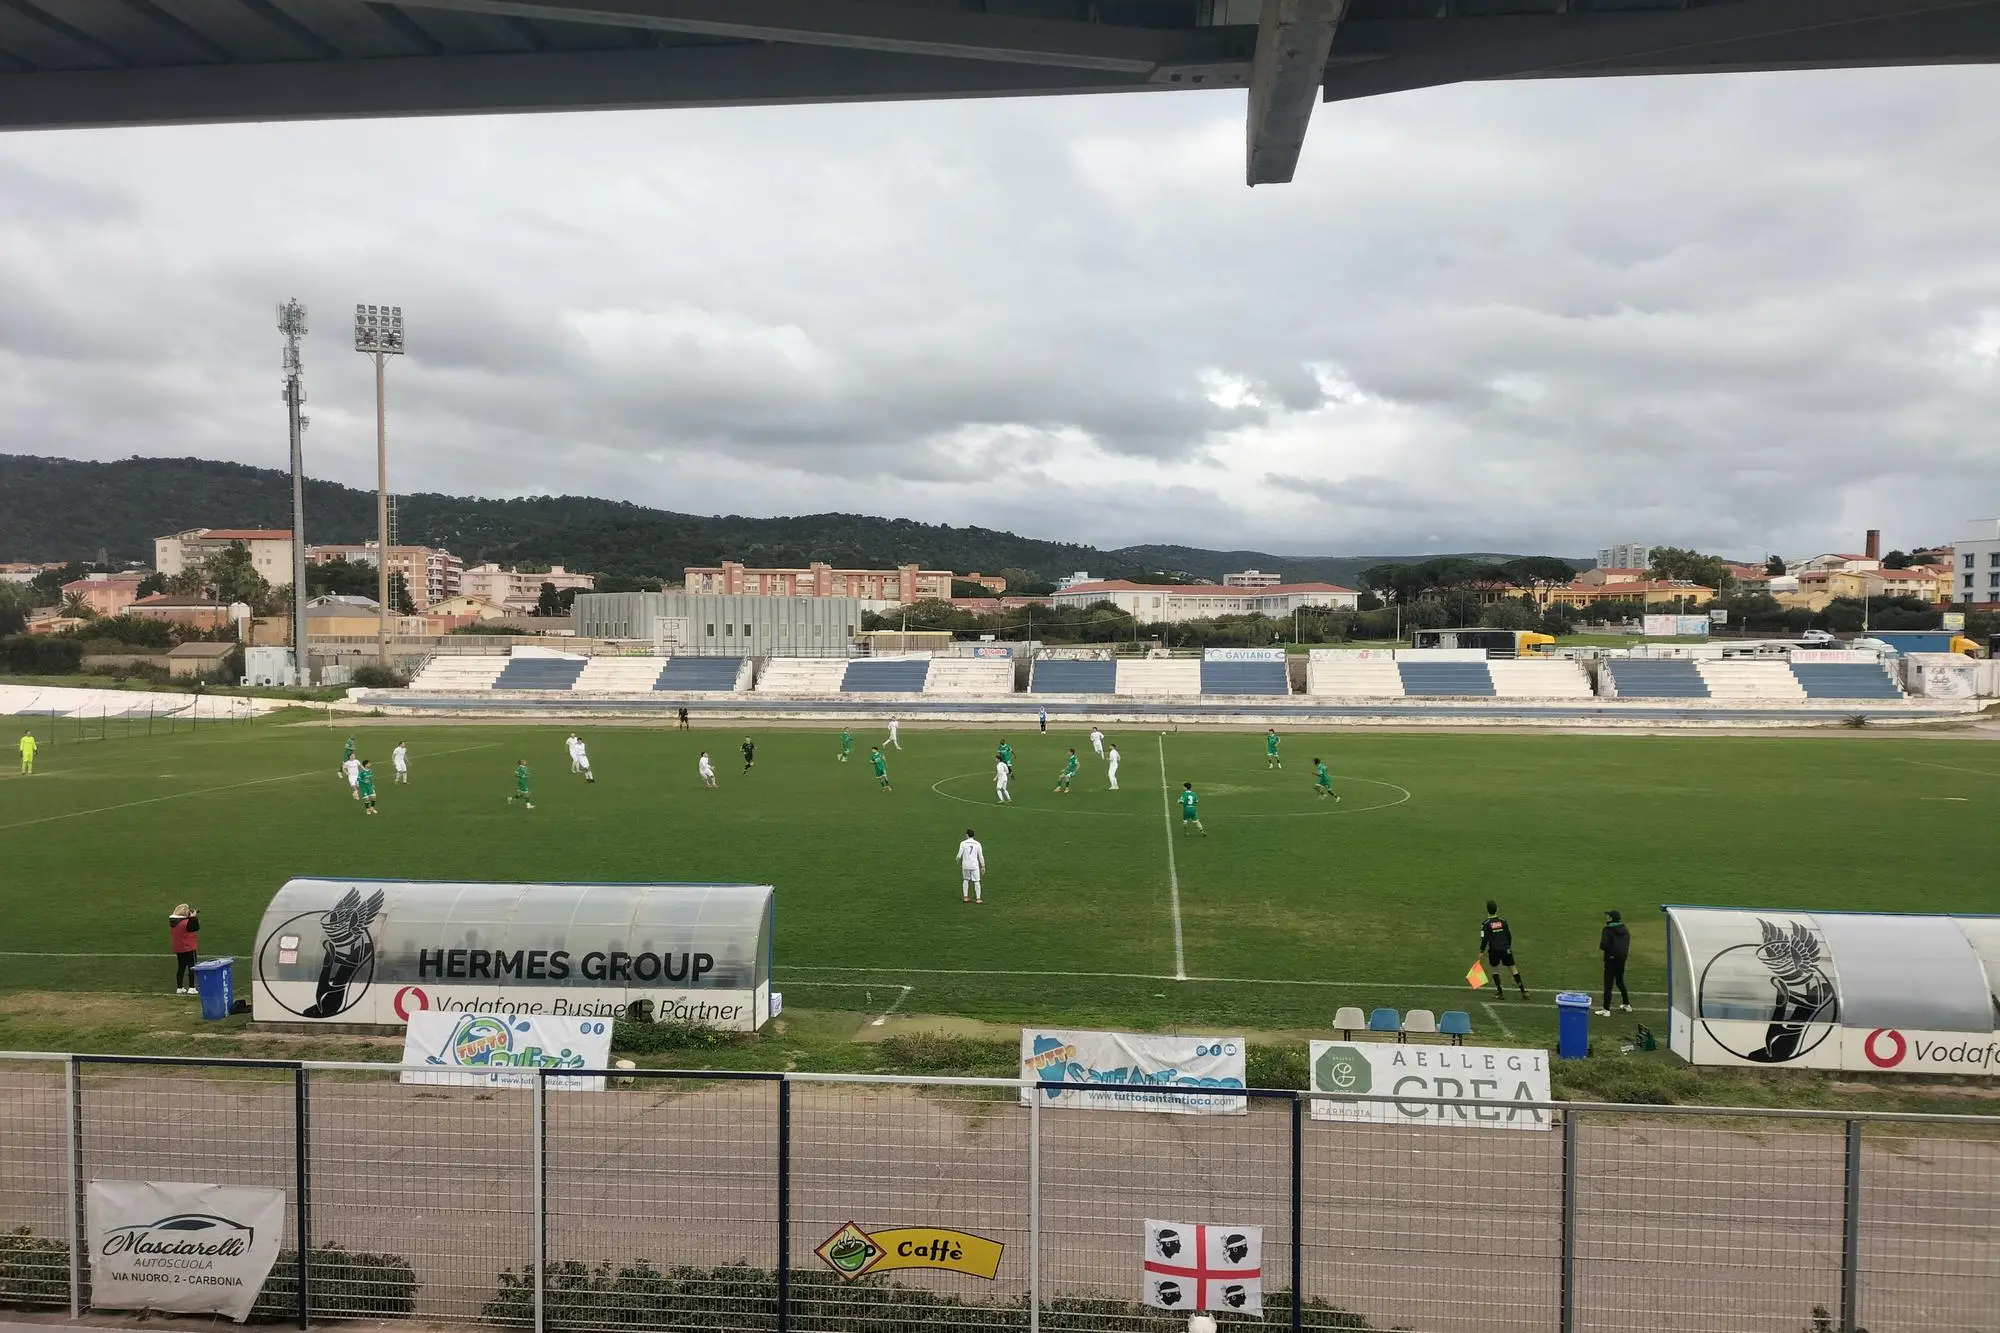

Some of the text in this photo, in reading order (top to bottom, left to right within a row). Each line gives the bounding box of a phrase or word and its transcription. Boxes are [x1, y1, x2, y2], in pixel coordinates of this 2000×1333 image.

[1225, 651, 1271, 659] GAVIANO
[1187, 795, 1193, 805] 3
[969, 846, 974, 855] 7
[419, 949, 713, 981] HERMES GROUP
[659, 1000, 743, 1020] Partner
[456, 1031, 508, 1060] TUTTO
[1025, 1044, 1077, 1072] TUTTO
[1392, 1051, 1541, 1072] AELLEGI
[1088, 1091, 1235, 1106] www.tuttosantantioco.com
[1392, 1076, 1543, 1123] CREA
[102, 1231, 244, 1256] Masciarelli
[898, 1239, 962, 1261] Caffè
[133, 1258, 213, 1270] AUTOSCUOLA
[112, 1272, 129, 1281] VIA
[131, 1273, 172, 1283] NUORO,
[174, 1275, 180, 1283] 2
[188, 1275, 243, 1286] CARBONIA
